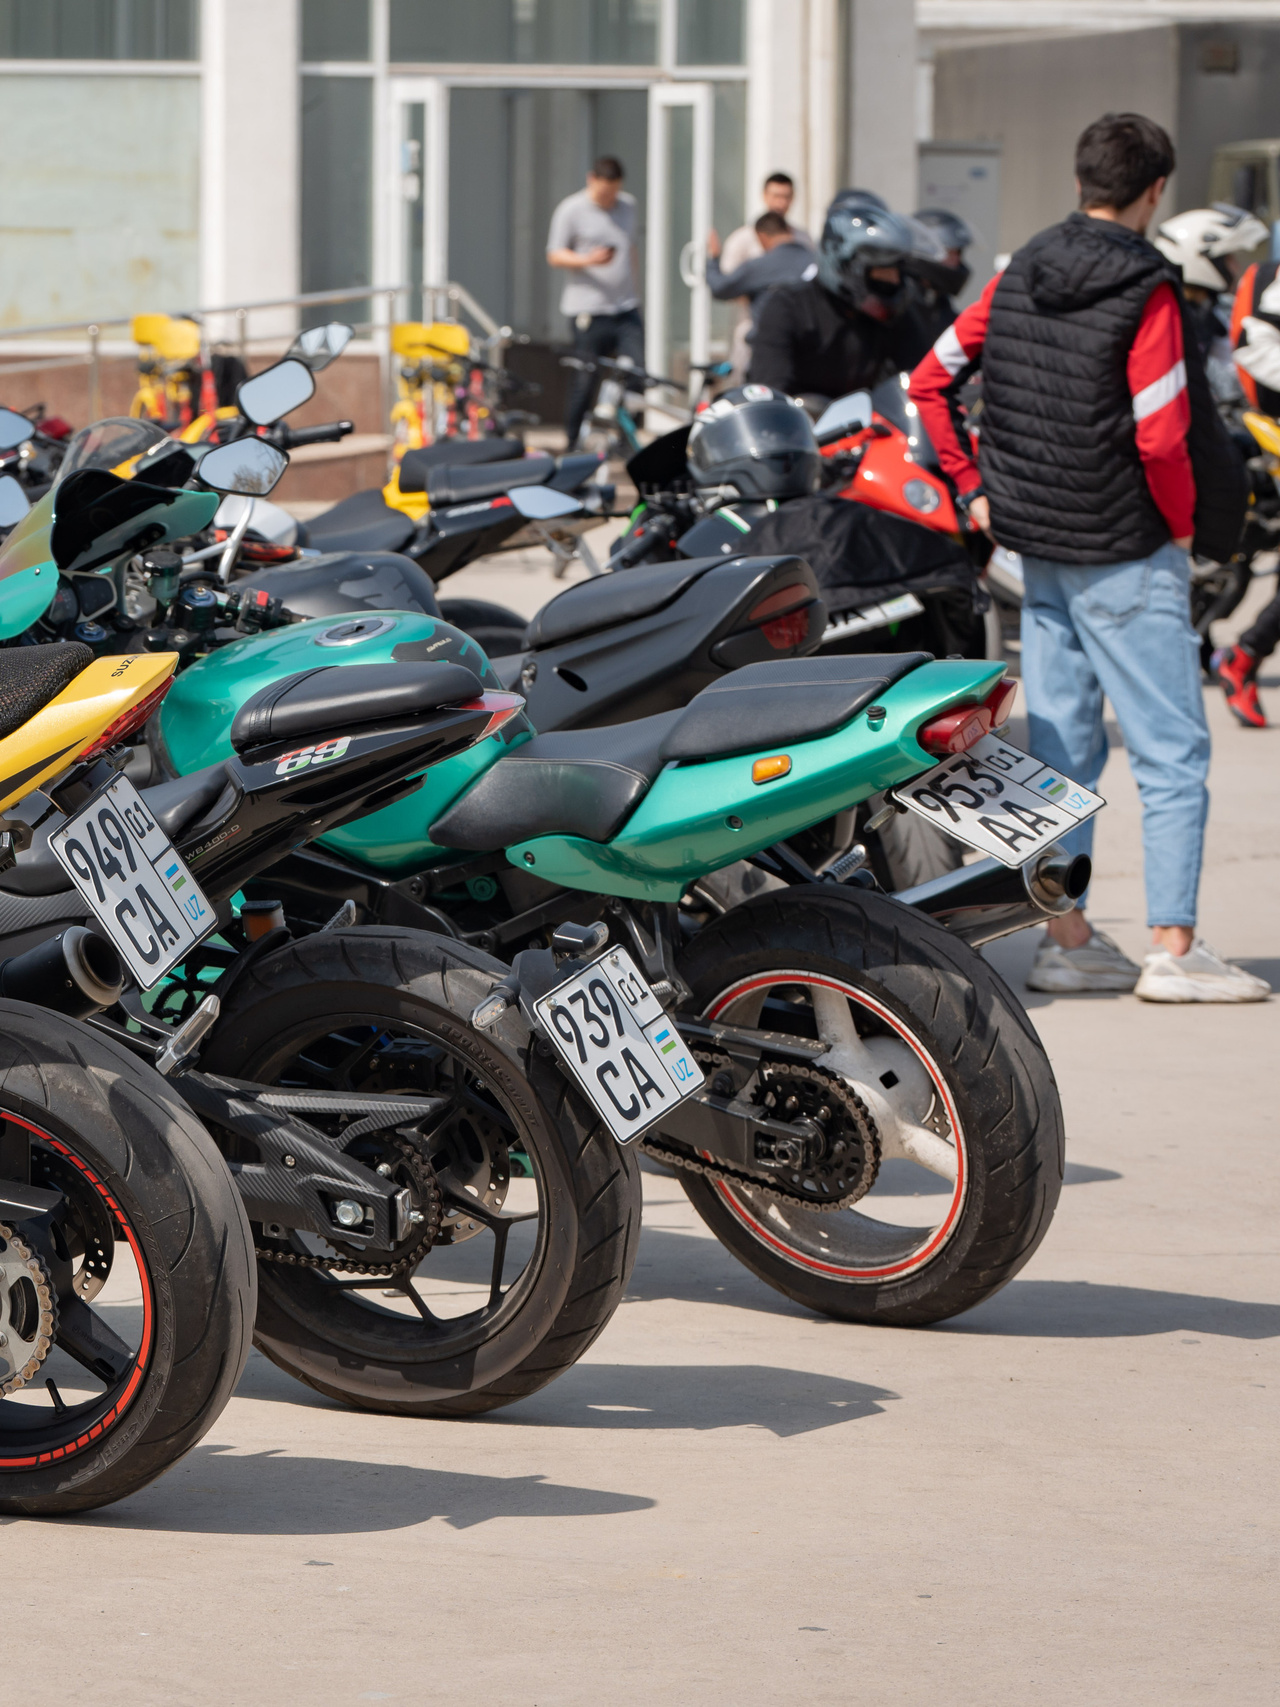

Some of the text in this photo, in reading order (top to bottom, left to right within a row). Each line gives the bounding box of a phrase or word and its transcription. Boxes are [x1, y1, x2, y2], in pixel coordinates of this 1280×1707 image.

[275, 736, 351, 775] 69
[985, 748, 1024, 771] 01
[911, 759, 1005, 823] 953
[1064, 792, 1091, 810] UZ
[124, 801, 155, 839] 01
[977, 800, 1059, 853] AA
[64, 808, 138, 903] 949
[115, 883, 180, 965] CA
[183, 894, 205, 921] UZ
[617, 972, 649, 1006] 01
[550, 978, 625, 1064] 939
[596, 1047, 665, 1121] CA
[672, 1057, 694, 1082] UZ
